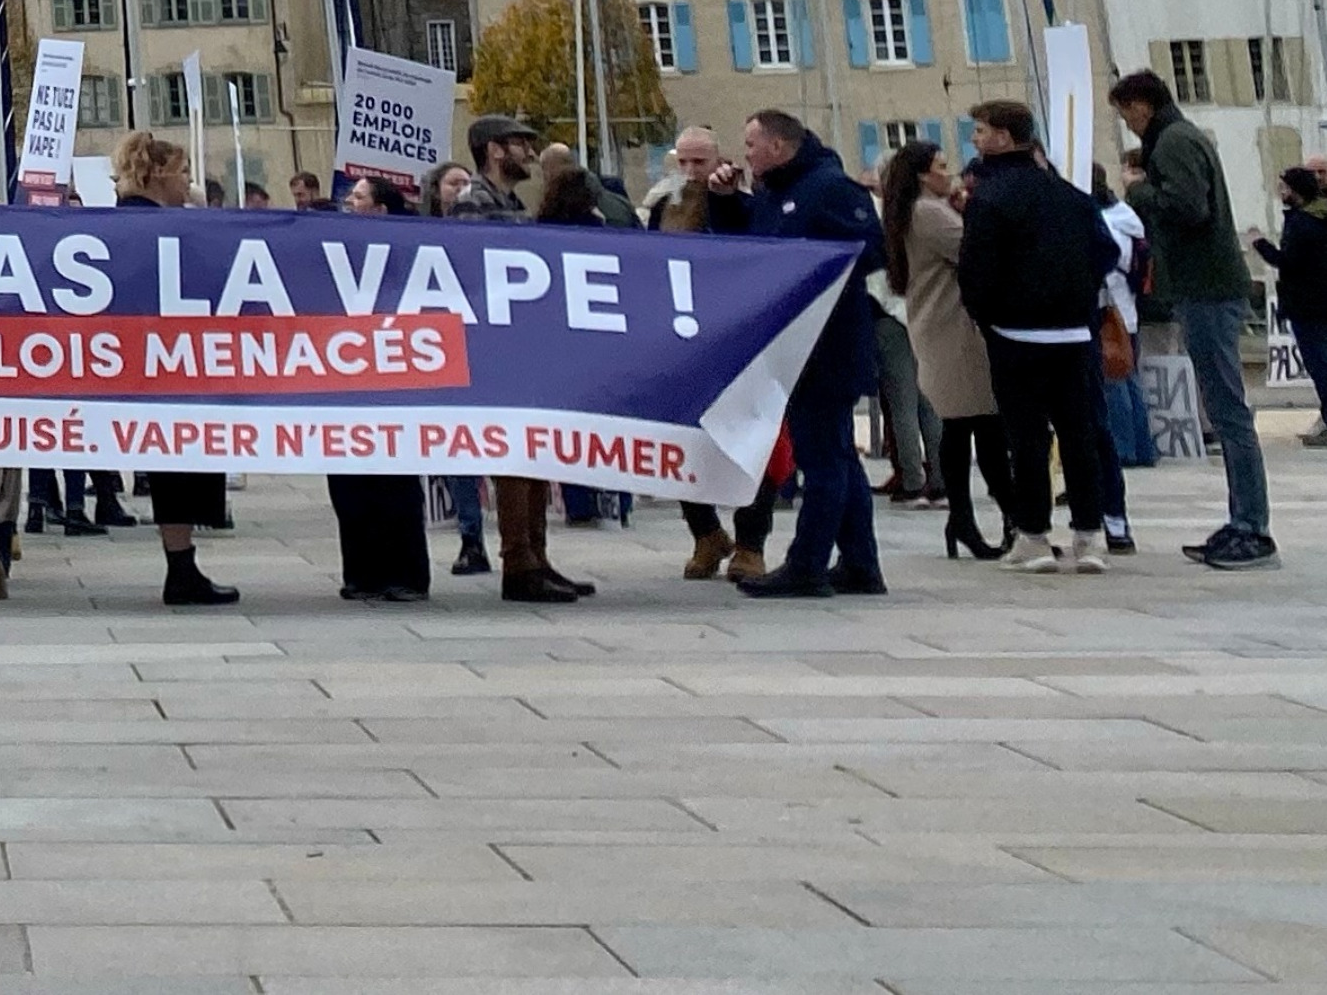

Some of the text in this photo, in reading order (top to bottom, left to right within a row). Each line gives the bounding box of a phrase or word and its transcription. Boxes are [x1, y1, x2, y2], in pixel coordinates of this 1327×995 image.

[36, 85, 75, 109] NE TUEZ
[354, 93, 414, 120] 20 000
[32, 109, 65, 134] PAS LA
[353, 111, 432, 144] EMPLOIS
[29, 133, 56, 159] VAPE
[158, 235, 296, 317] LA
[321, 241, 628, 333] VAPE
[668, 258, 700, 340] !
[144, 317, 447, 379] MENACÉS
[112, 419, 259, 458] VAPER
[276, 424, 404, 458] N'EST
[418, 424, 511, 459] PAS
[525, 426, 698, 484] FUMER.
